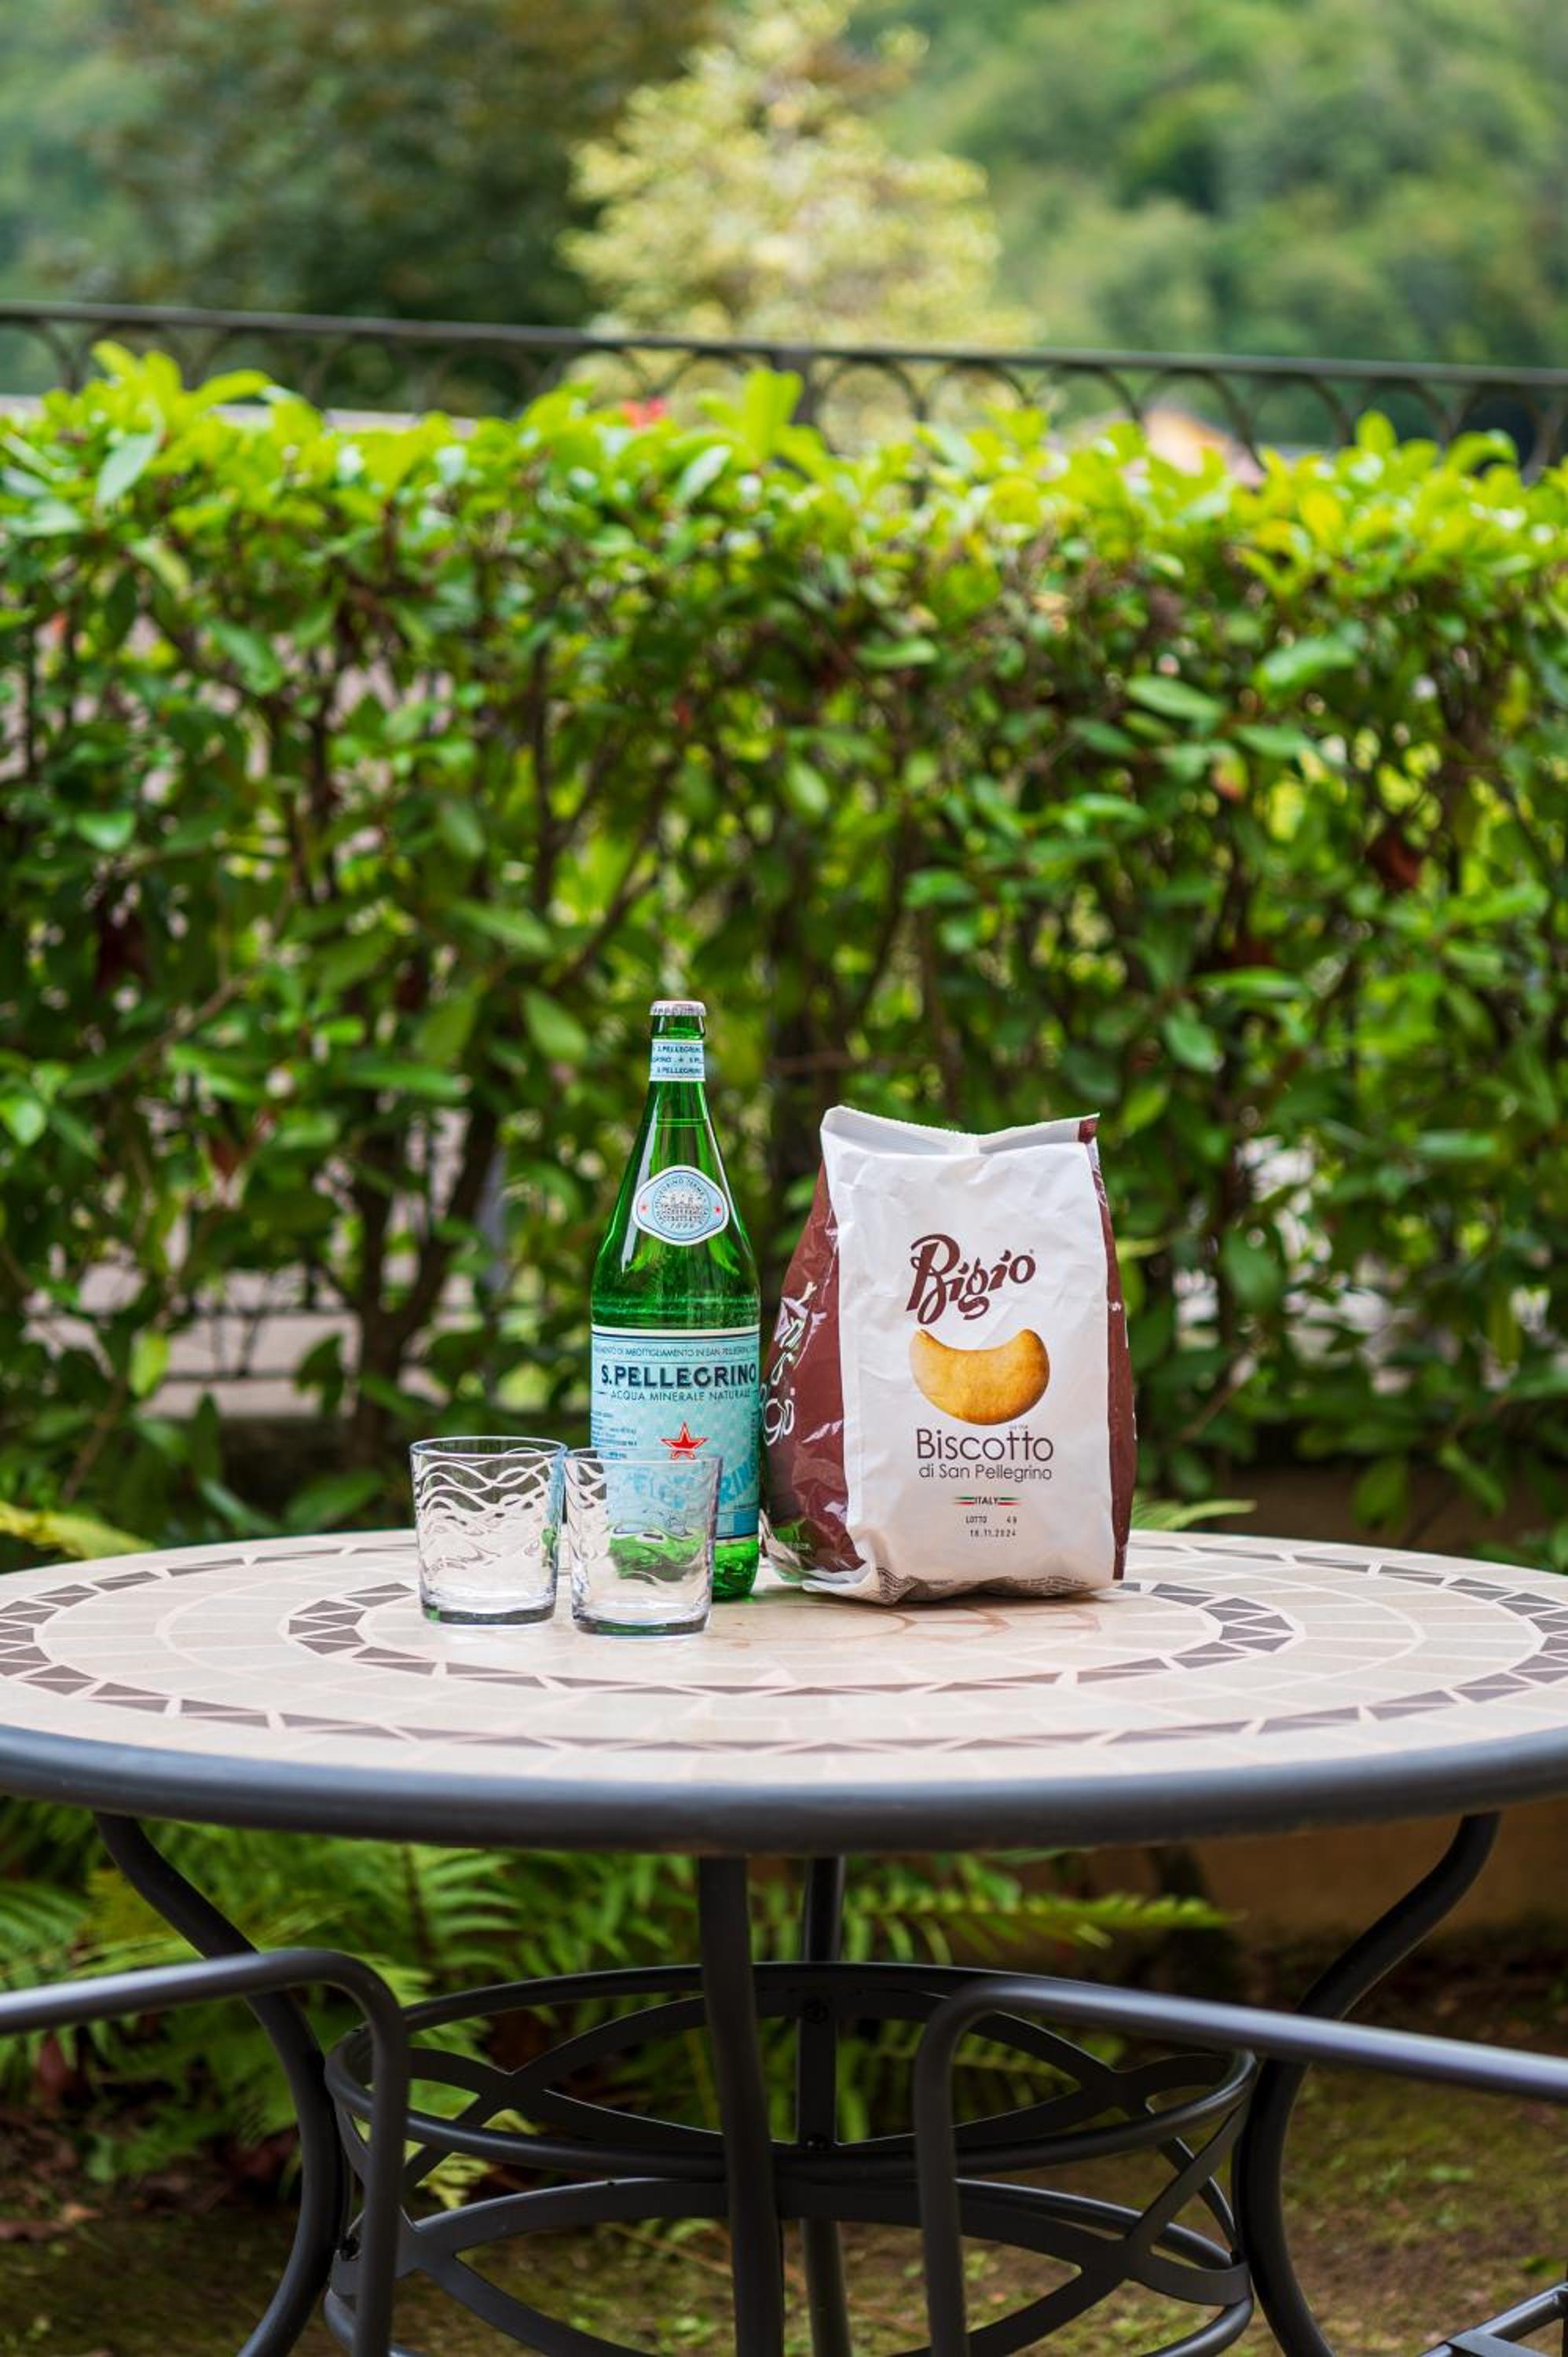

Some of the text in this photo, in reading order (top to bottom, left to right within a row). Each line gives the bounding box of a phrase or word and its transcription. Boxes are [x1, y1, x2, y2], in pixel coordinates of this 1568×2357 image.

[906, 1233, 1036, 1325] Bigio
[601, 1363, 757, 1388] S.PELLEGRINO
[610, 1388, 750, 1402] ACQUA MINERALE NATURALE
[917, 1428, 1054, 1462] Biscotto
[918, 1463, 1053, 1483] di San Pellegrino
[974, 1496, 998, 1505] ITALY
[965, 1515, 987, 1524] LOTTO
